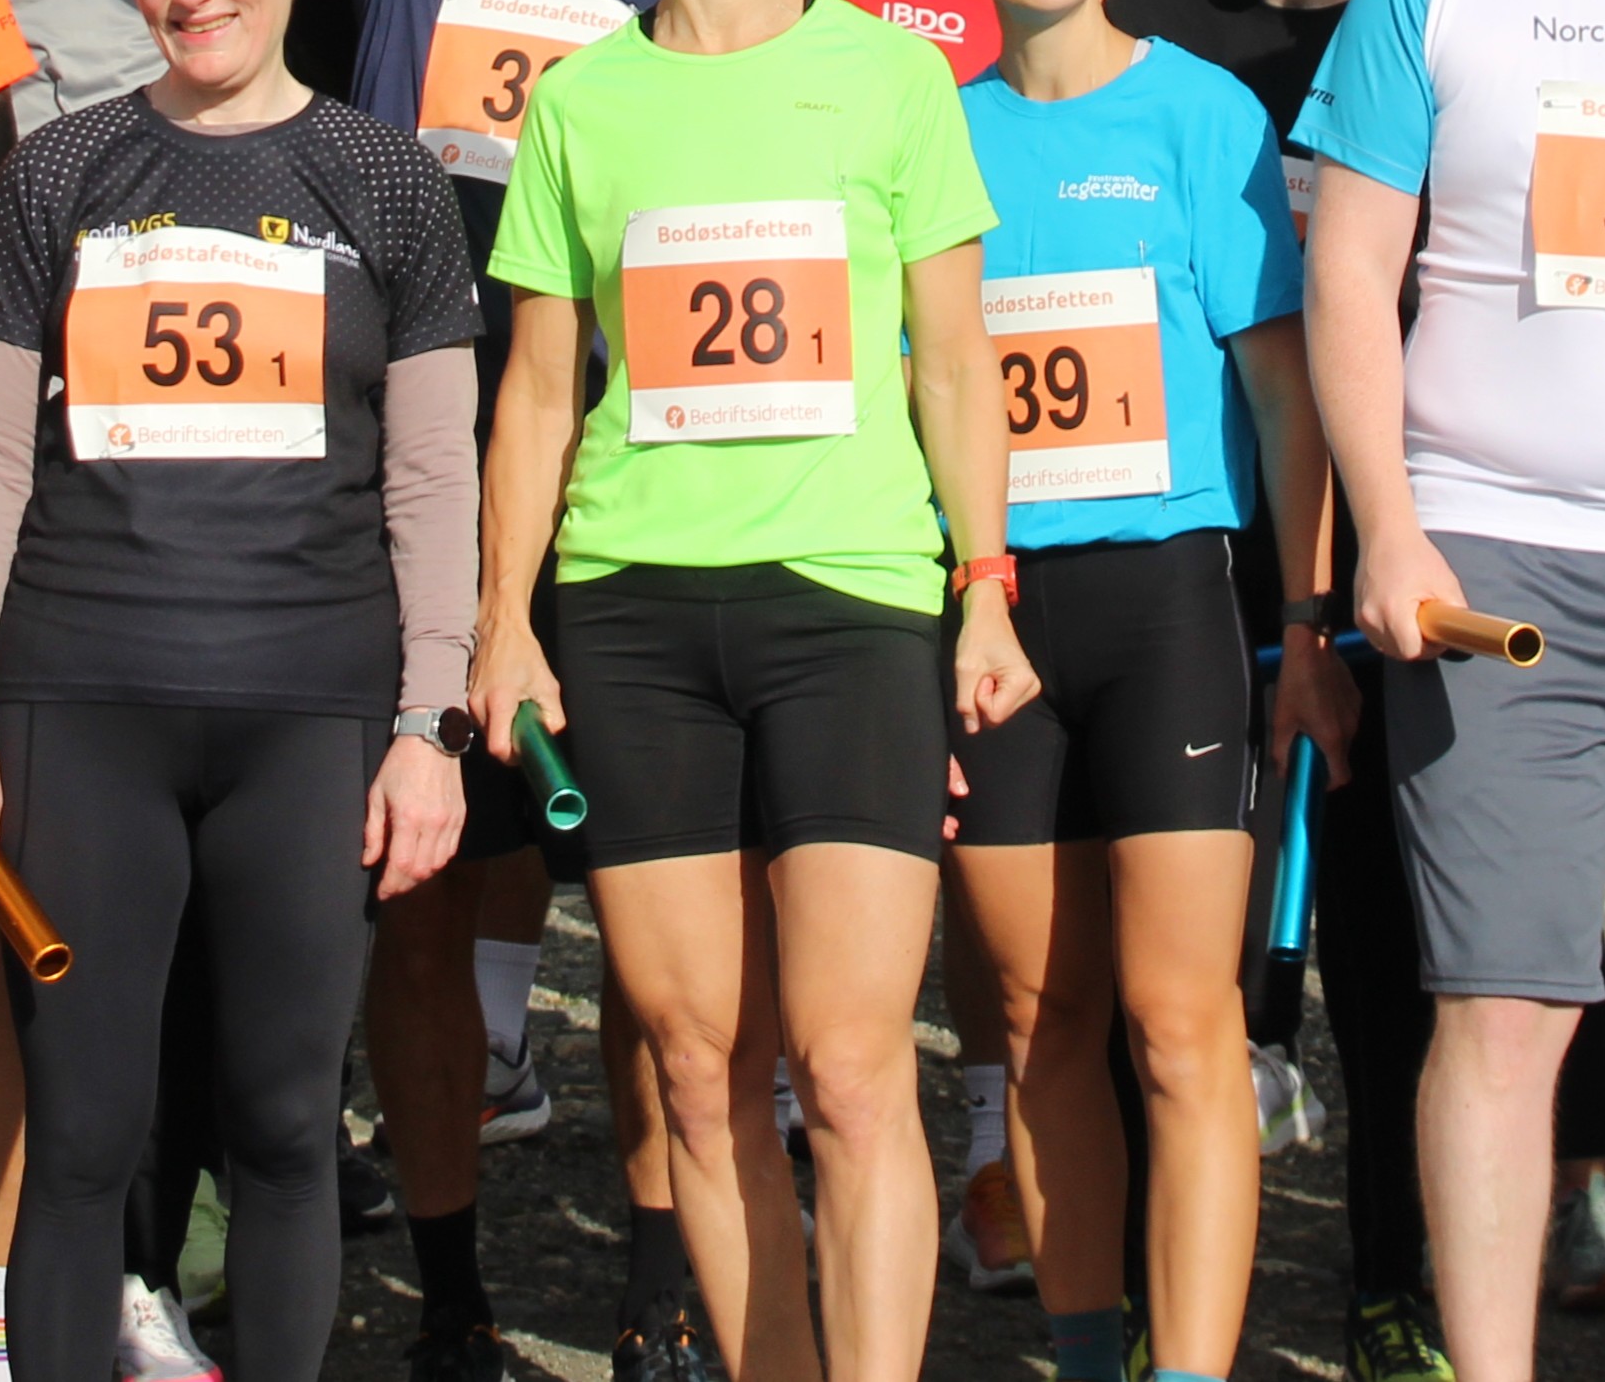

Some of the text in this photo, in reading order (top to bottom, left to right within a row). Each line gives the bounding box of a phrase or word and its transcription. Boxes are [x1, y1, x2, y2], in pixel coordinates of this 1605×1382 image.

[482, 48, 566, 123] 3
[1058, 180, 1160, 201] Legesenter
[657, 219, 813, 244] Bodøstafetten
[123, 243, 280, 274] Bodøstafetten
[984, 289, 1115, 315] odøstafetten
[689, 277, 823, 368] 28 1
[142, 301, 288, 387] 53 1
[1000, 346, 1132, 435] 39 1
[690, 403, 823, 426] Bedriftsidretten
[138, 425, 285, 445] Bedriftsidretten
[1007, 466, 1133, 490] edriftsidretten
